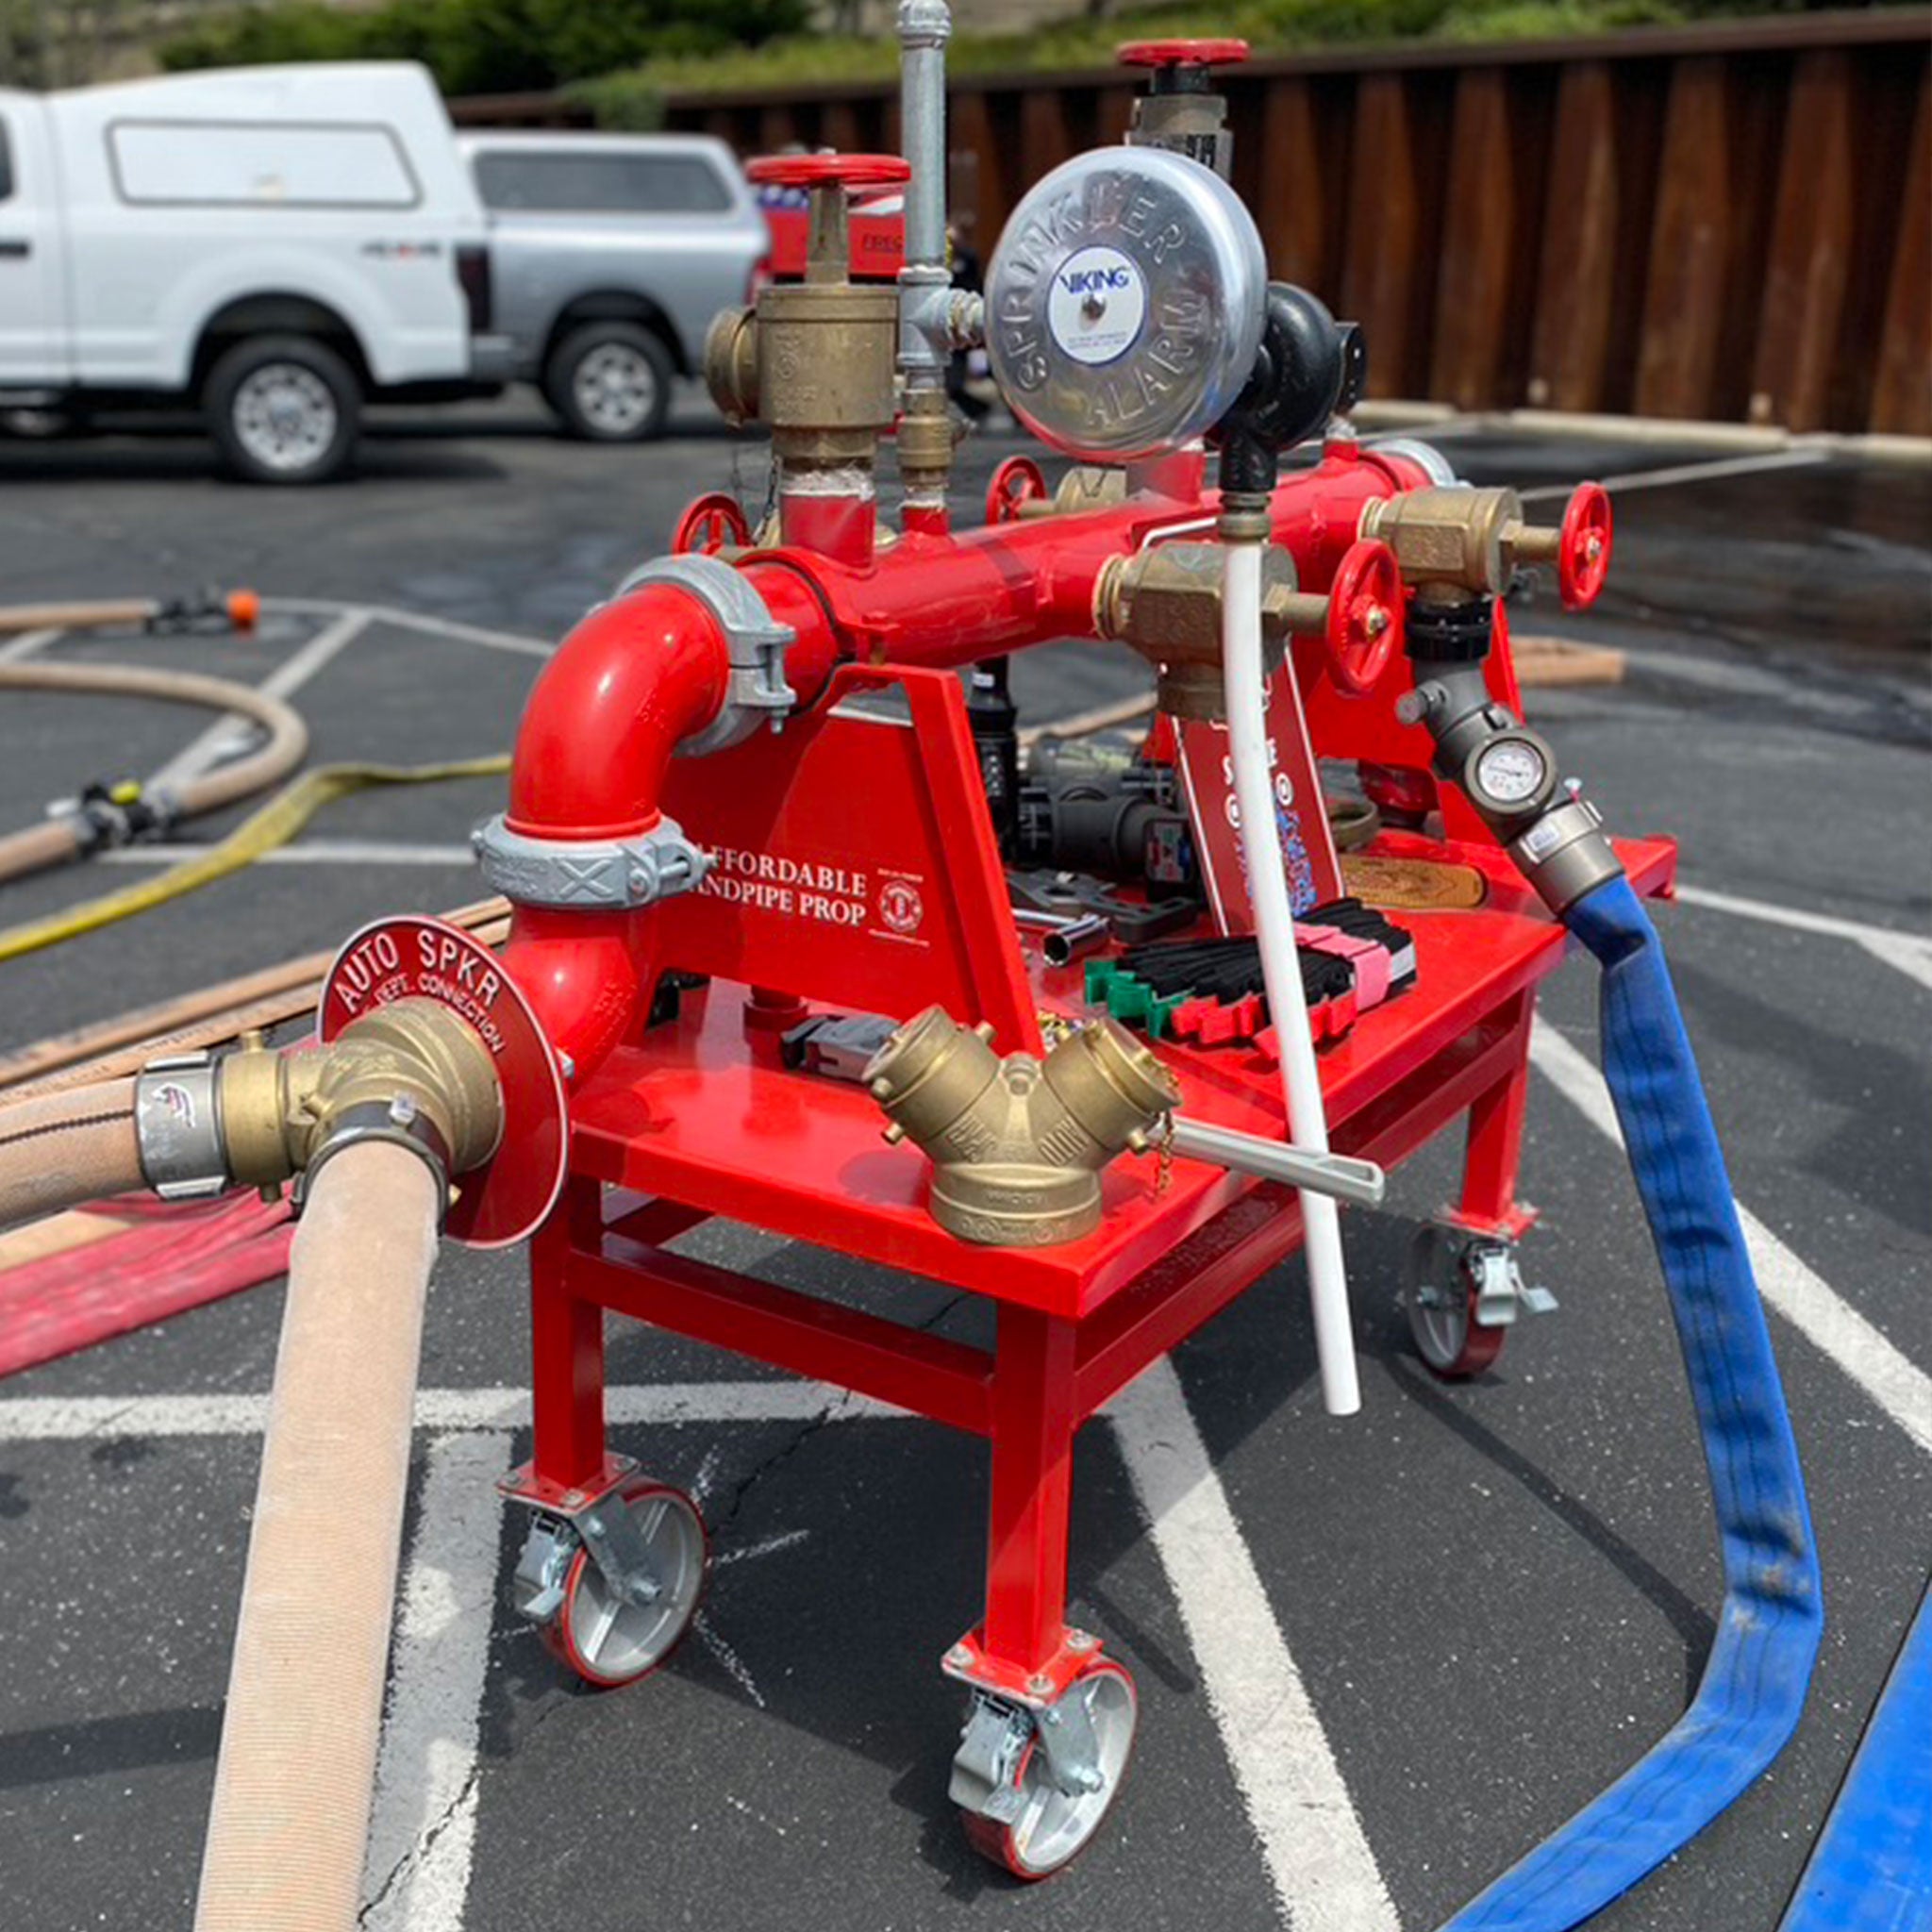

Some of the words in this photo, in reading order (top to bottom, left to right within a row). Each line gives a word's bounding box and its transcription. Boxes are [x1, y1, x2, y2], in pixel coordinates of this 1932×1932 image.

[1000, 185, 1184, 392] SPRINKLER
[1058, 266, 1130, 293] VIKING
[1088, 286, 1208, 426] ALARM
[699, 842, 867, 897] FFORDABLE
[799, 892, 866, 926] PROP
[335, 932, 399, 1014] AUTO
[417, 930, 499, 1007] SPKR
[417, 973, 505, 1053] CONNECTION
